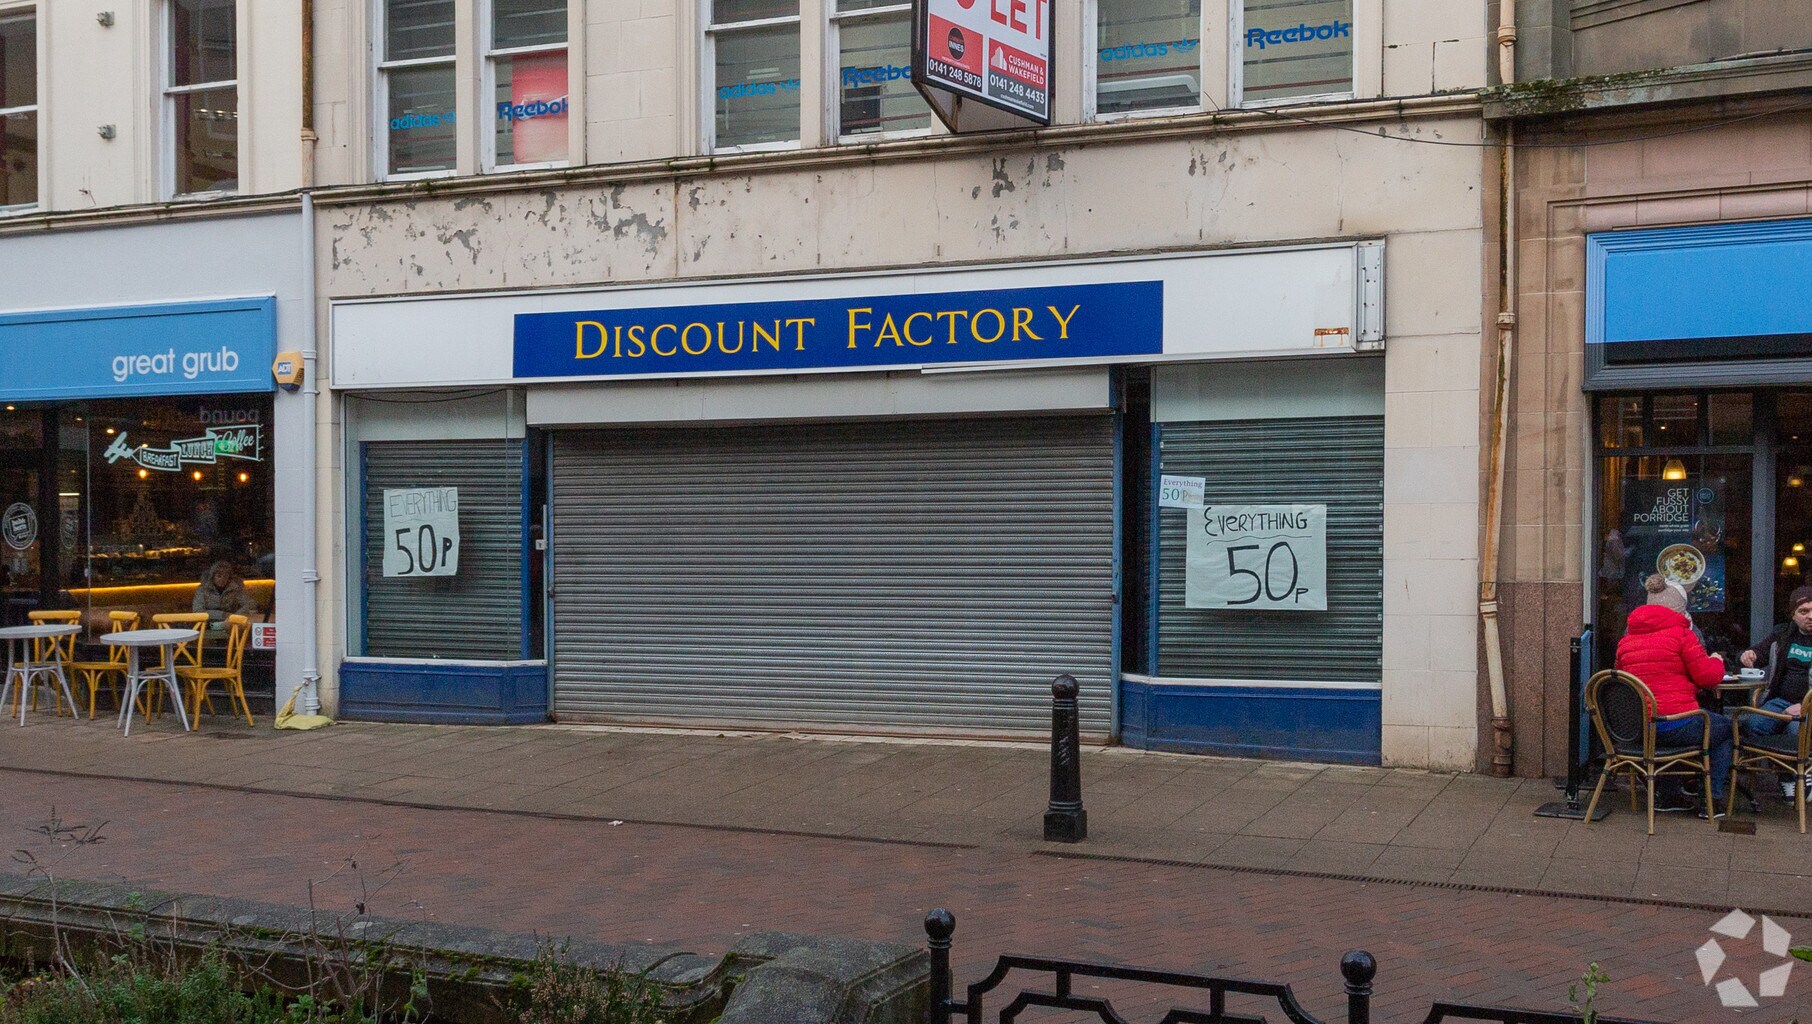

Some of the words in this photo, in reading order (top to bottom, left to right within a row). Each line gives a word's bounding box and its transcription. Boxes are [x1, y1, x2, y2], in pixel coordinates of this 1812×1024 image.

[1247, 20, 1349, 50] Reebok
[1100, 40, 1169, 63] adidas
[842, 64, 911, 88] Reebo
[929, 58, 947, 76] 0141
[949, 67, 962, 82] 248
[964, 71, 982, 88] 5878
[1008, 55, 1039, 74] CUSHMAN
[1039, 68, 1044, 76] &
[1008, 64, 1045, 85] WAKEFIELD
[719, 80, 777, 99] adidas
[989, 74, 1008, 91] 0141
[1009, 81, 1024, 97] 248
[1025, 87, 1045, 105] 4433
[390, 113, 441, 130] adidas
[574, 316, 816, 360] DISCOUNT
[846, 303, 1082, 350] FACTORY
[112, 347, 175, 382] great
[182, 346, 239, 379] grub
[278, 363, 291, 373] ADT
[181, 441, 215, 460] LUNCH
[217, 429, 255, 452] Coffee
[142, 450, 178, 467] BREAKFAST
[1163, 478, 1203, 489] Everything
[1667, 488, 1689, 497] GET
[389, 489, 457, 518] EVERYTHING
[1651, 505, 1689, 514] ABOUT
[1656, 497, 1689, 506] FUSSY
[1633, 513, 1689, 522] PORRIDGE
